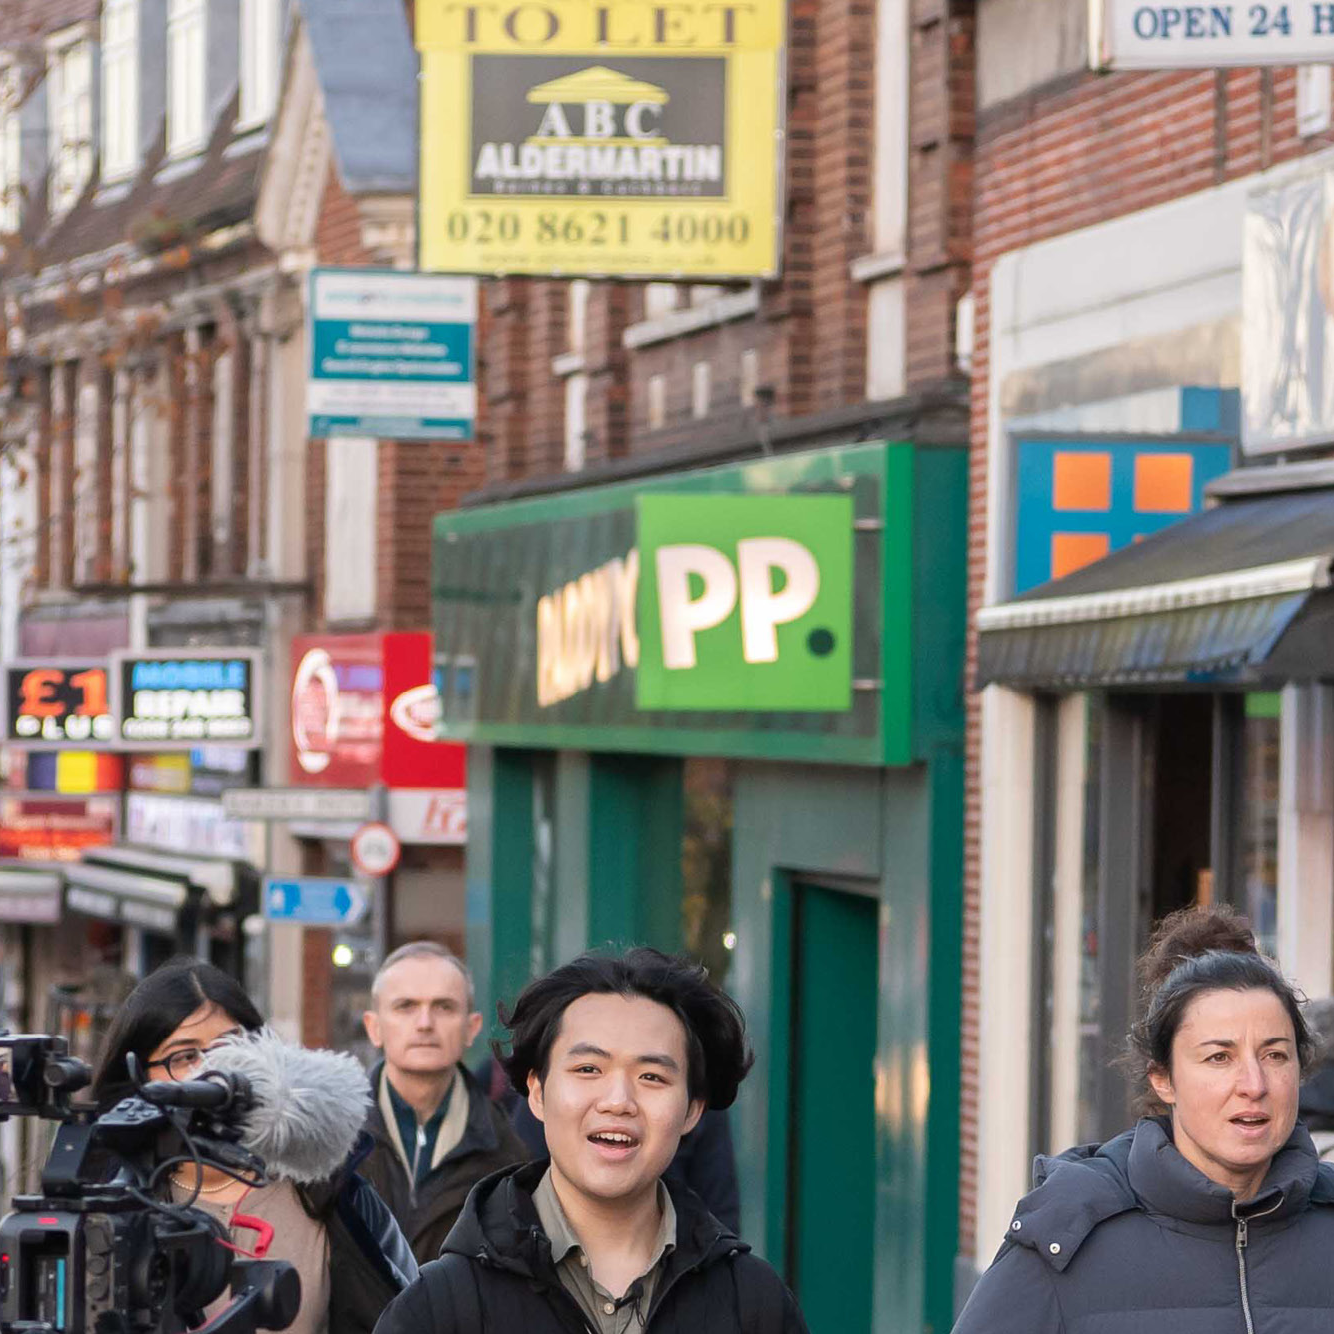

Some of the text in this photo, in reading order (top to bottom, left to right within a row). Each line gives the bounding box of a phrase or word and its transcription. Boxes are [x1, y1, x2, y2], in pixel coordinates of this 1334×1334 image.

[445, 3, 755, 47] TO LET
[1133, 6, 1231, 39] OPEN
[1249, 4, 1290, 36] 24
[474, 142, 722, 181] ALDERMARTIN
[448, 210, 750, 246] 020 8621 4000
[19, 669, 109, 716] £1
